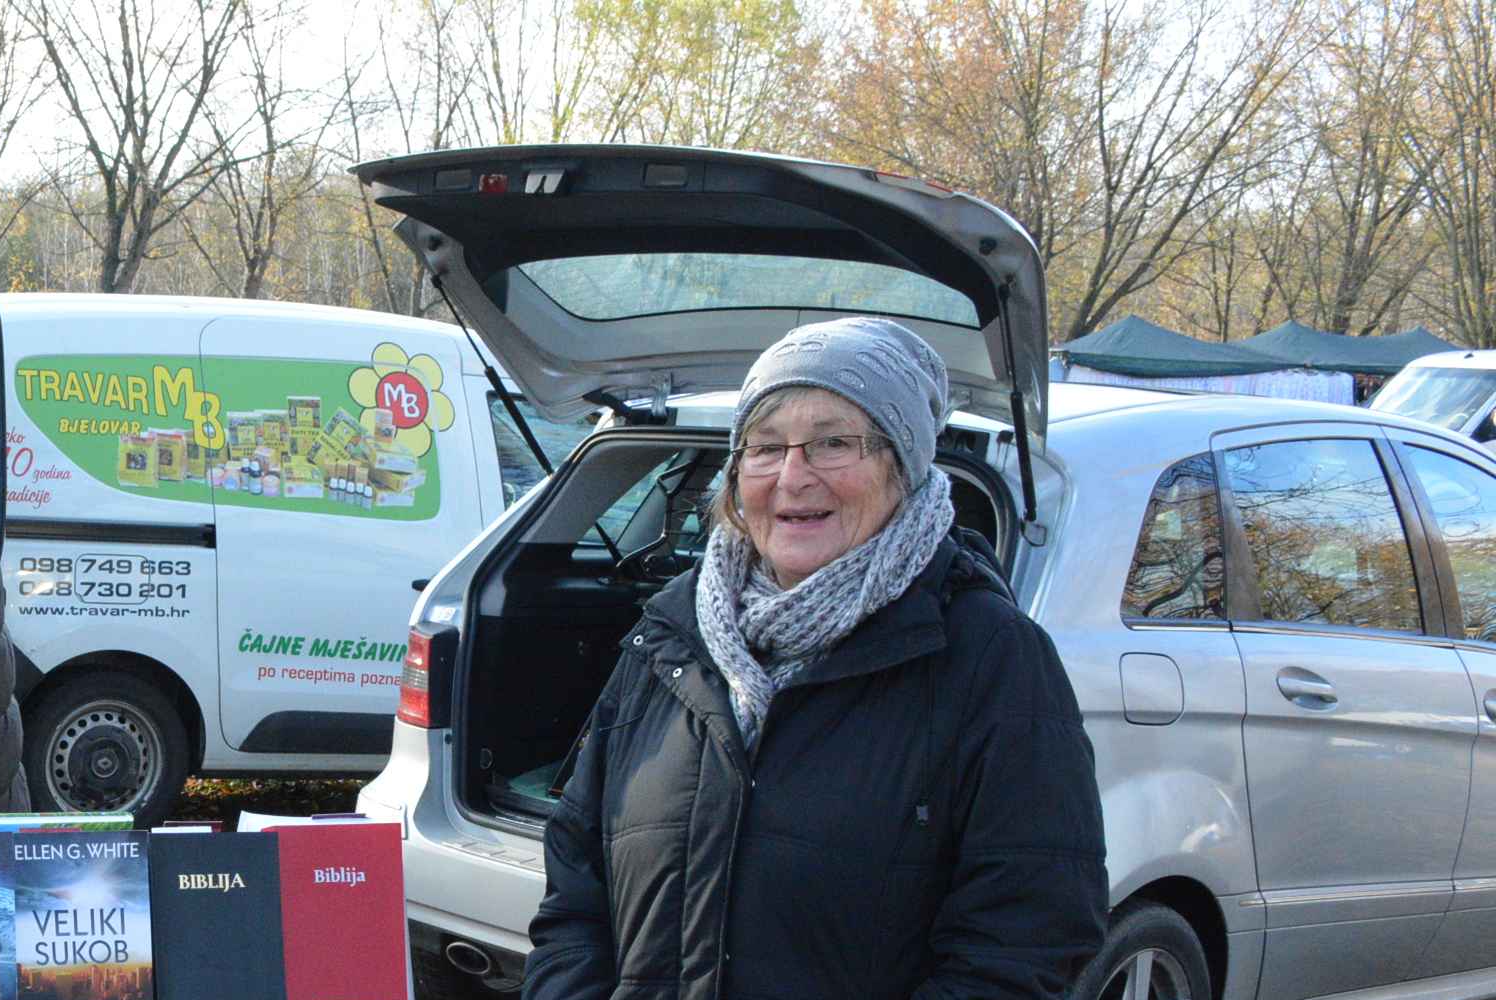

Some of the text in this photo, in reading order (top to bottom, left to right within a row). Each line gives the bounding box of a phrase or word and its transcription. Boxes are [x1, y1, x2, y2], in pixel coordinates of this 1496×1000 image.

[17, 364, 225, 449] TRAVAR MB
[384, 383, 420, 417] MB
[59, 417, 141, 434] BJELOVAR
[33, 464, 72, 483] godina
[20, 558, 191, 576] 098 749 663
[80, 582, 132, 597] 730
[139, 583, 187, 599] 201
[19, 606, 190, 618] www.travar-mb.hr
[238, 628, 408, 662] ČAJNE MJEŠAVIN
[258, 667, 401, 687] po receptima pozna
[14, 842, 140, 861] ELLEN G. WHITE
[179, 873, 246, 893] BIBLIJA
[314, 866, 366, 888] Biblija
[32, 907, 126, 938] VELIKI
[35, 940, 129, 966] SUKOB
